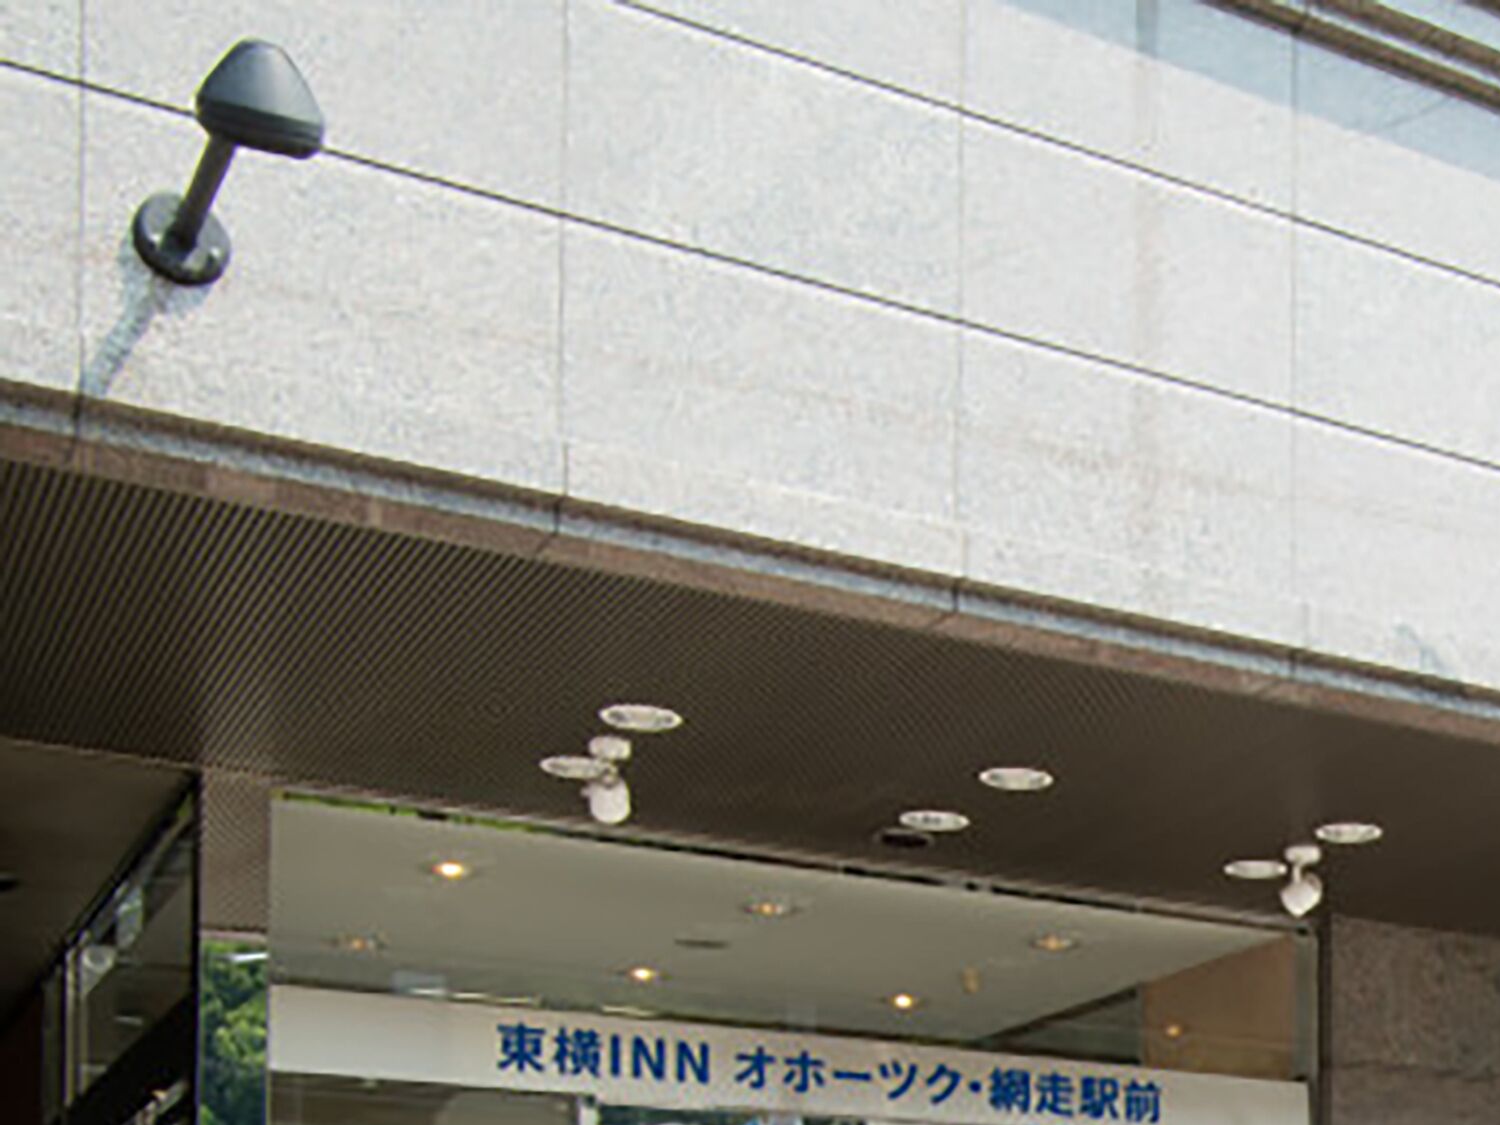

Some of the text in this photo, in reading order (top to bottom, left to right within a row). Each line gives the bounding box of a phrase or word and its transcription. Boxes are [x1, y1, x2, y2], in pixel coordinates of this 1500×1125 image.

[497, 1021, 1162, 1124] 東横INN オホーツク・網走駅前
